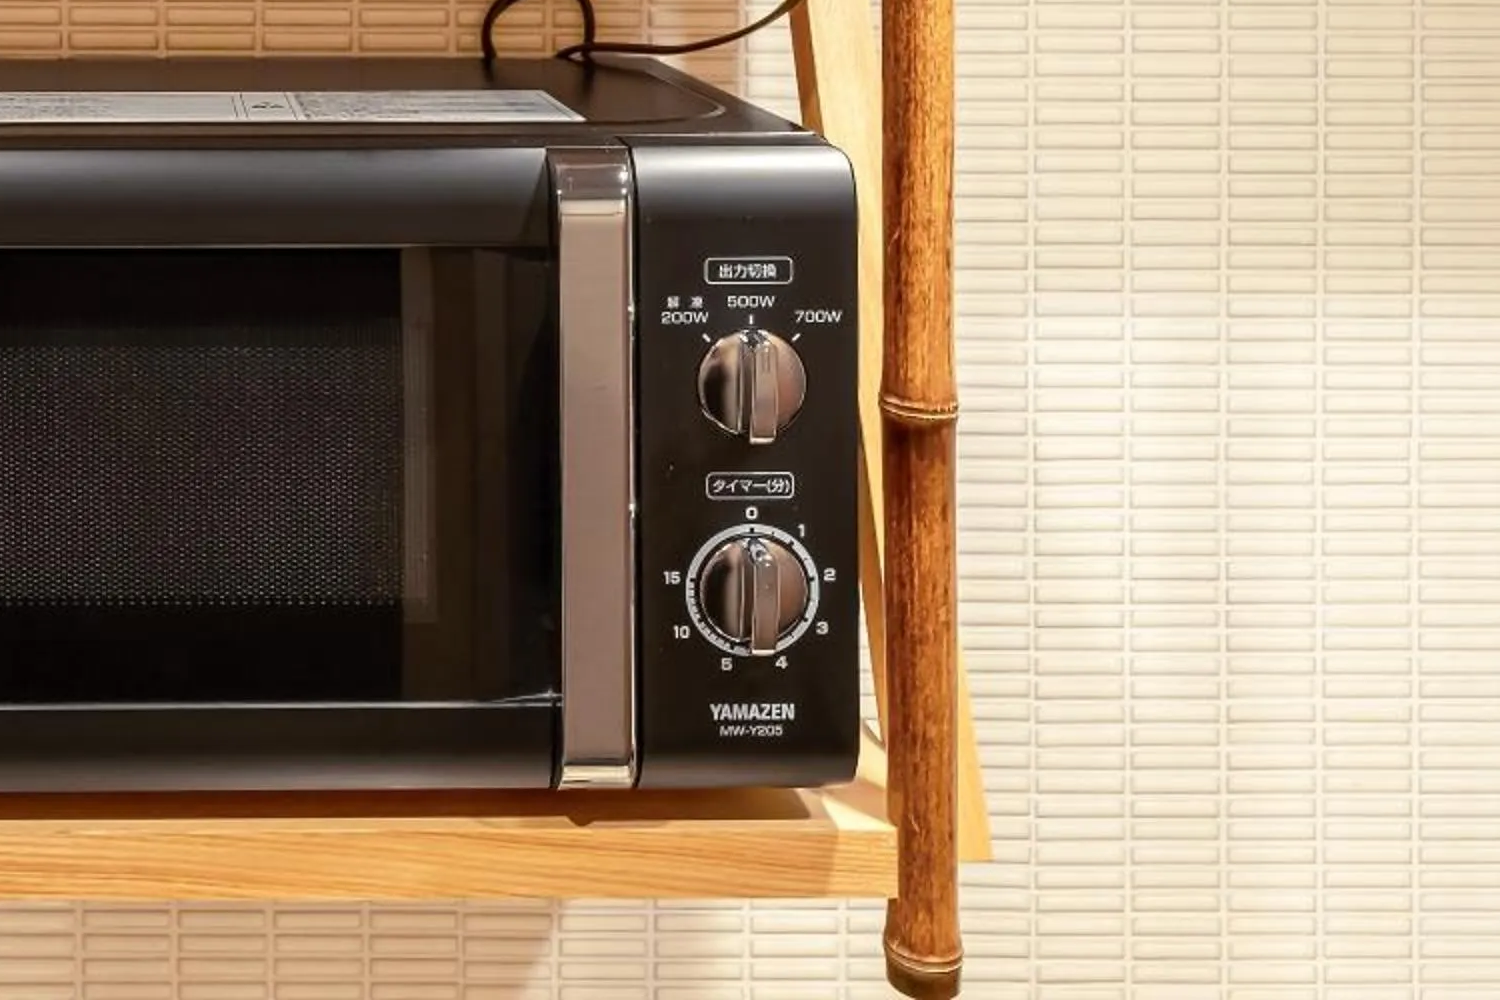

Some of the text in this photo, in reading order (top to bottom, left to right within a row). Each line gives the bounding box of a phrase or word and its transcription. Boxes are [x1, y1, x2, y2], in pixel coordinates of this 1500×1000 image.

[719, 263, 777, 279] 出力切換
[727, 295, 775, 308] 500W
[661, 311, 709, 325] 200W
[795, 310, 843, 323] 700W
[745, 506, 758, 519] 0
[799, 524, 806, 537] 1
[664, 571, 681, 585] 15
[824, 568, 837, 581] 2
[674, 625, 690, 639] 10
[816, 621, 829, 635] 3
[721, 658, 733, 671] 5
[775, 656, 788, 669] 4
[709, 703, 796, 720] YAMAZEN
[719, 725, 783, 737] MW-Y205
